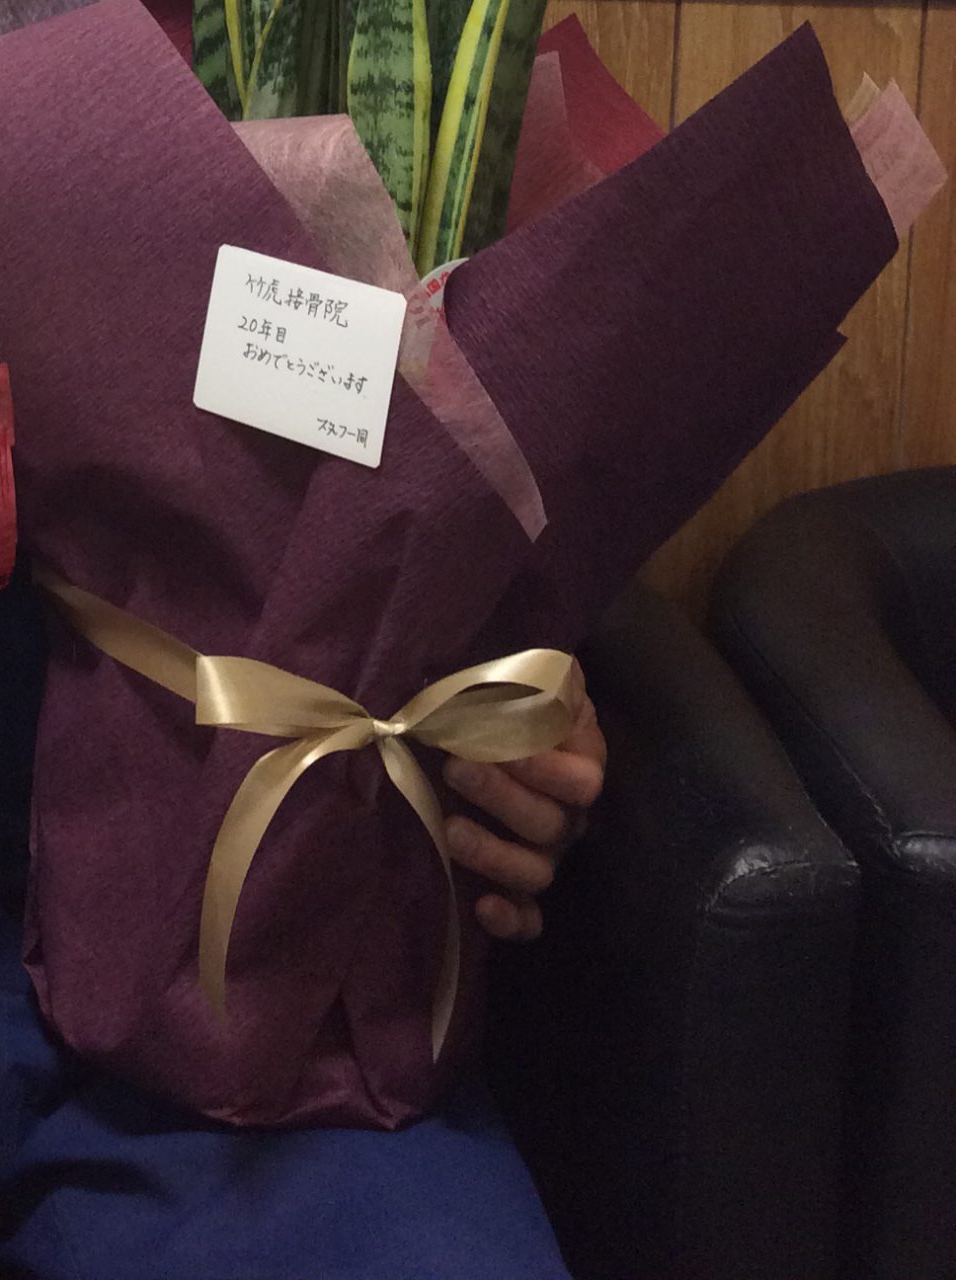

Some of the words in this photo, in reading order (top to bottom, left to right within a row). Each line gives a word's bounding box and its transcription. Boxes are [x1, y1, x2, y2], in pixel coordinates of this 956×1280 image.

[237, 316, 287, 344] 20年目
[243, 342, 368, 394] おめでとうございます
